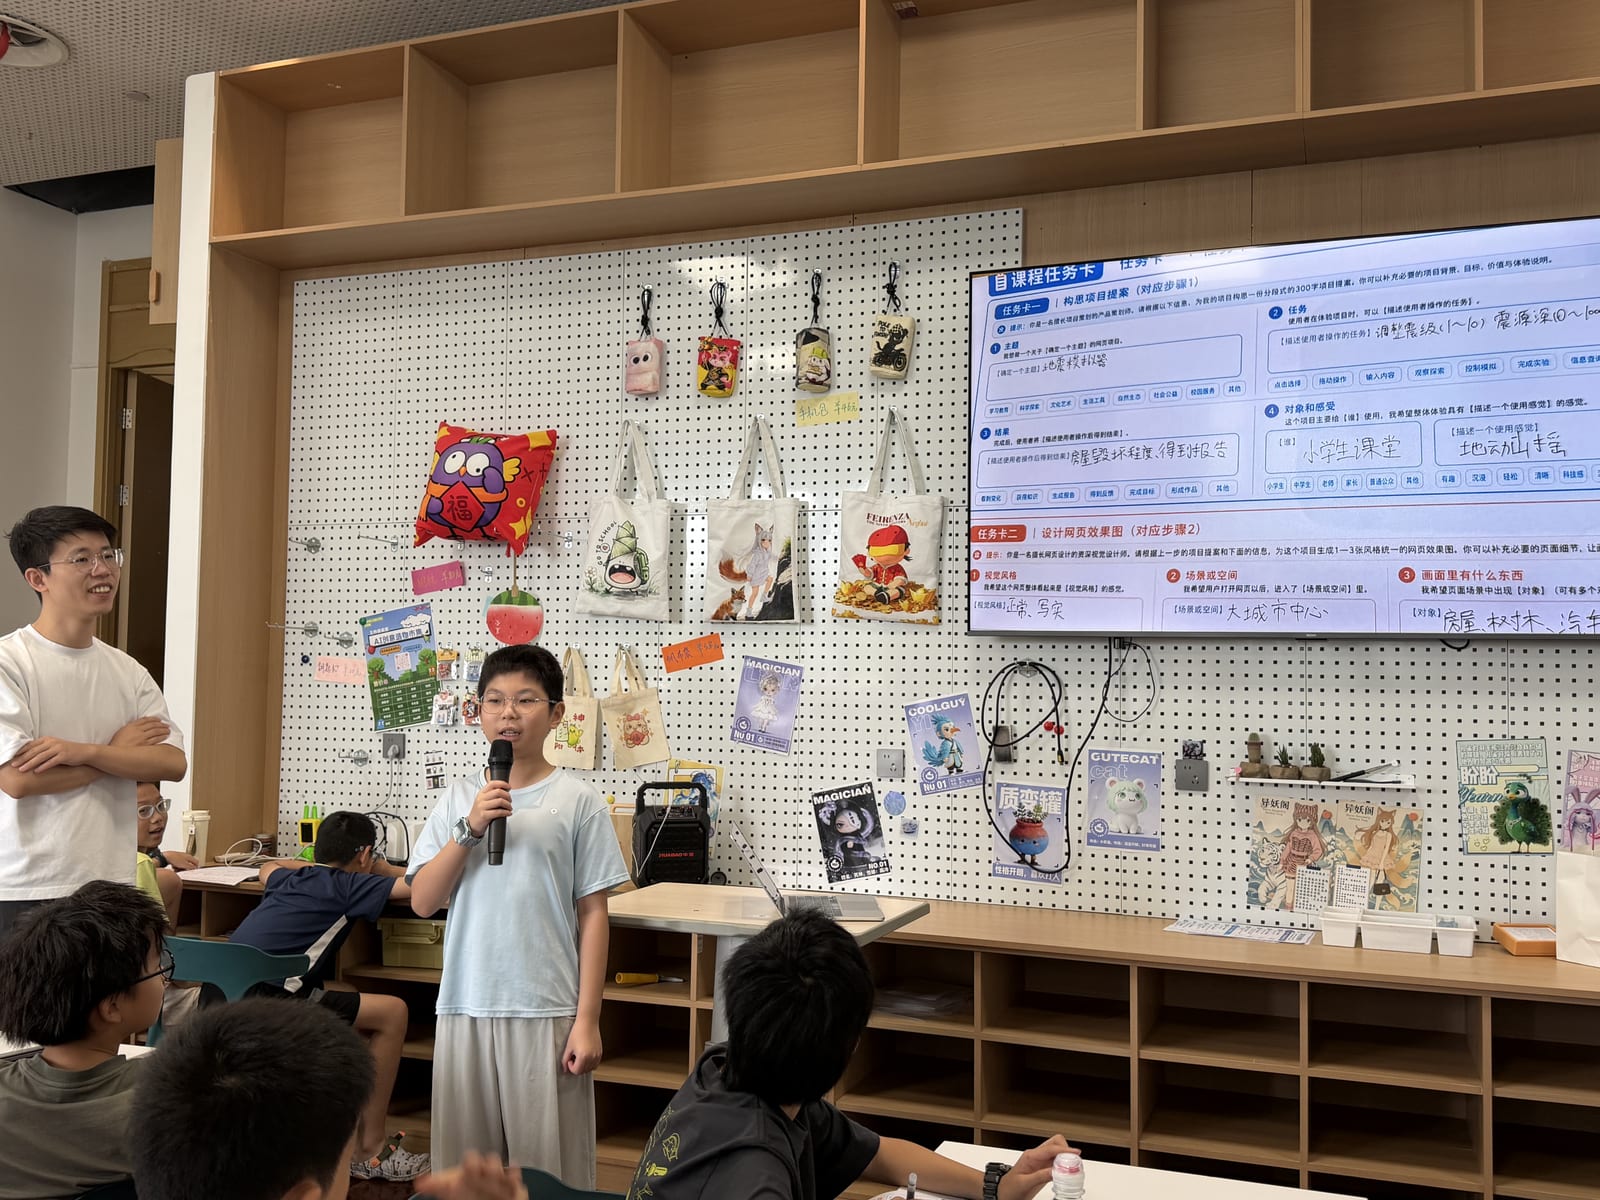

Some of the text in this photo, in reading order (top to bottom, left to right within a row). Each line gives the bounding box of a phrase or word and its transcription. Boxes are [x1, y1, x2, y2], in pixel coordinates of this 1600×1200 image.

[1011, 264, 1096, 288] 课程任务卡
[1003, 303, 1041, 316] 任务卡一
[1288, 305, 1307, 315] 任务
[1004, 341, 1019, 350] 主题
[1366, 371, 1395, 381] 输入内容
[1517, 359, 1550, 368] 完成实验
[1228, 385, 1241, 393] 其他
[1284, 401, 1336, 414] 对象和感受
[994, 428, 1009, 437] 结果
[1303, 435, 1401, 464] 小学生课堂
[1503, 473, 1518, 481] 轻松
[1534, 472, 1549, 480] 清晰
[1563, 470, 1584, 479] 科技感
[1171, 486, 1198, 495] 形成作品
[1216, 484, 1230, 493] 其他
[1267, 476, 1419, 491] 小学生 中学生 老师 家长 普通公众 其他
[446, 495, 473, 521] 福
[978, 528, 1018, 541] 任务卡二
[984, 571, 1017, 580] 视觉风格
[1185, 570, 1238, 581] 场景或空间
[1421, 569, 1524, 581] 画面里有什么东西
[1227, 598, 1329, 623] 大城市中心
[746, 659, 801, 677] MAGICIAN
[908, 697, 966, 717] COOLGUY
[1091, 752, 1158, 765] CUTECAT
[813, 786, 872, 805] MAGICIAN
